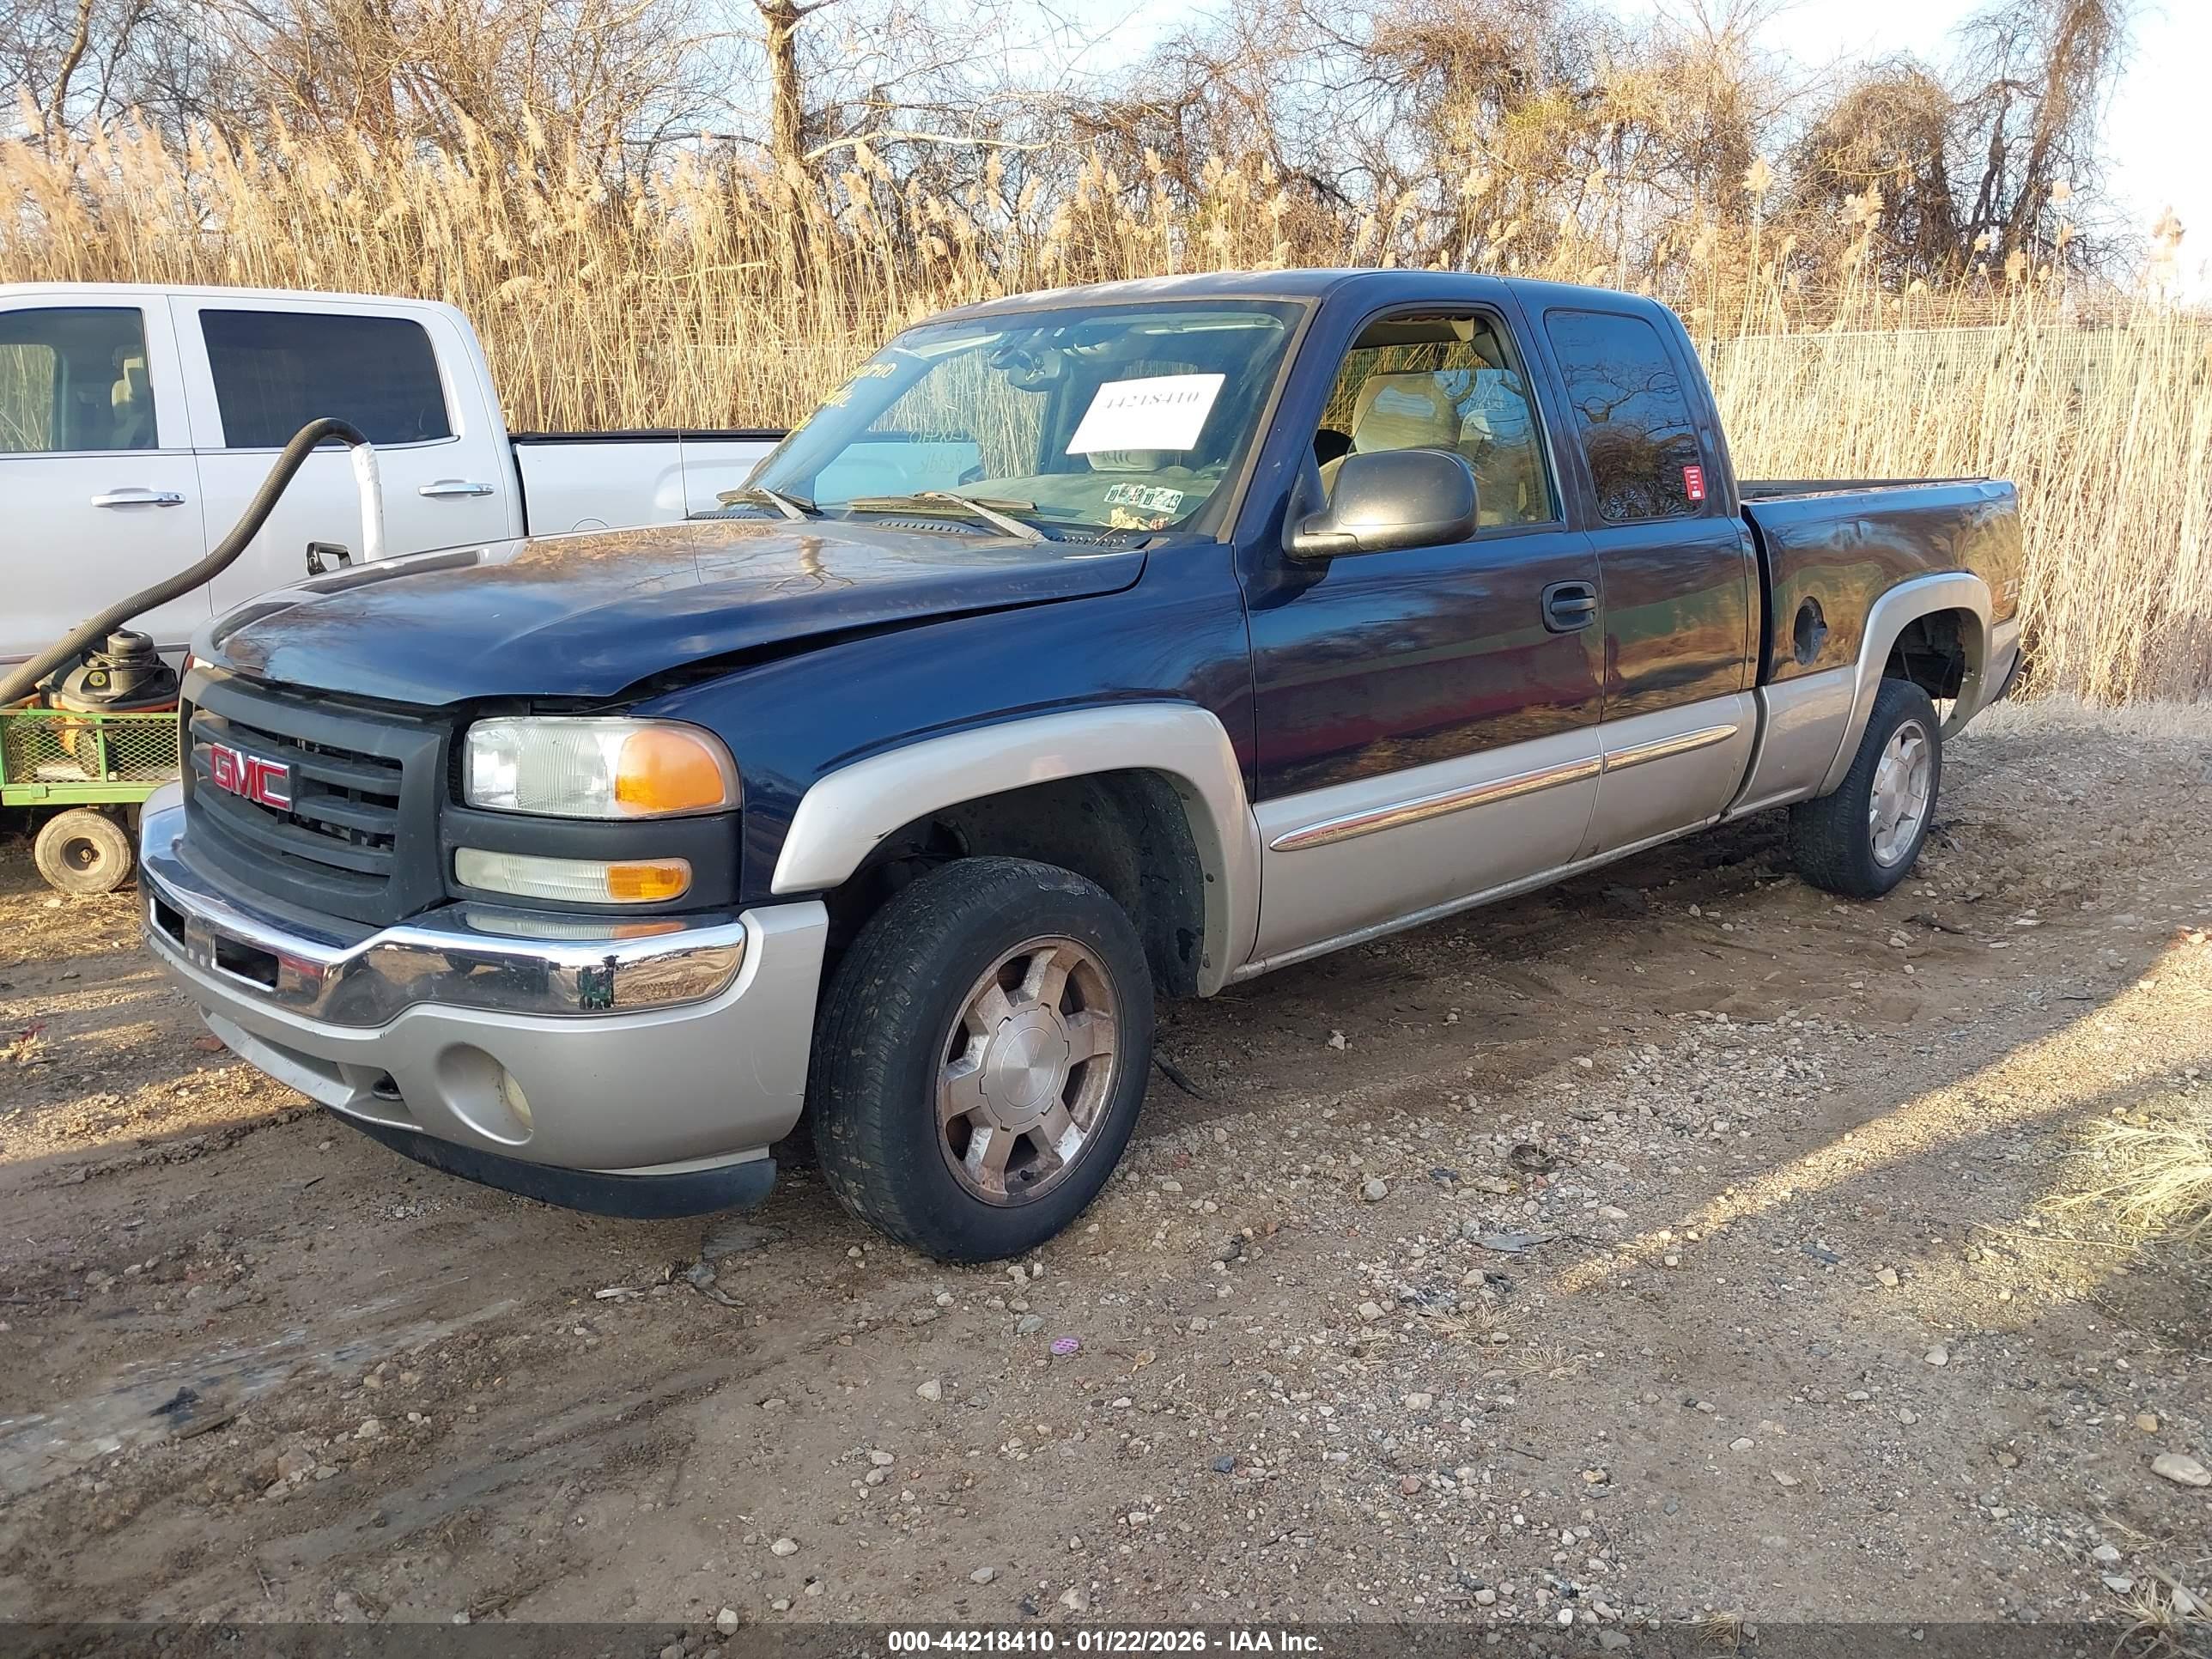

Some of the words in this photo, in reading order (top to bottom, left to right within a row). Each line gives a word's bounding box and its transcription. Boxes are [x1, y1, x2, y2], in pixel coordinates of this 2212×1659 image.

[1107, 489, 1119, 501] 10
[1143, 493, 1156, 506] 10
[1166, 494, 1182, 508] 13
[211, 743, 292, 812] GMC
